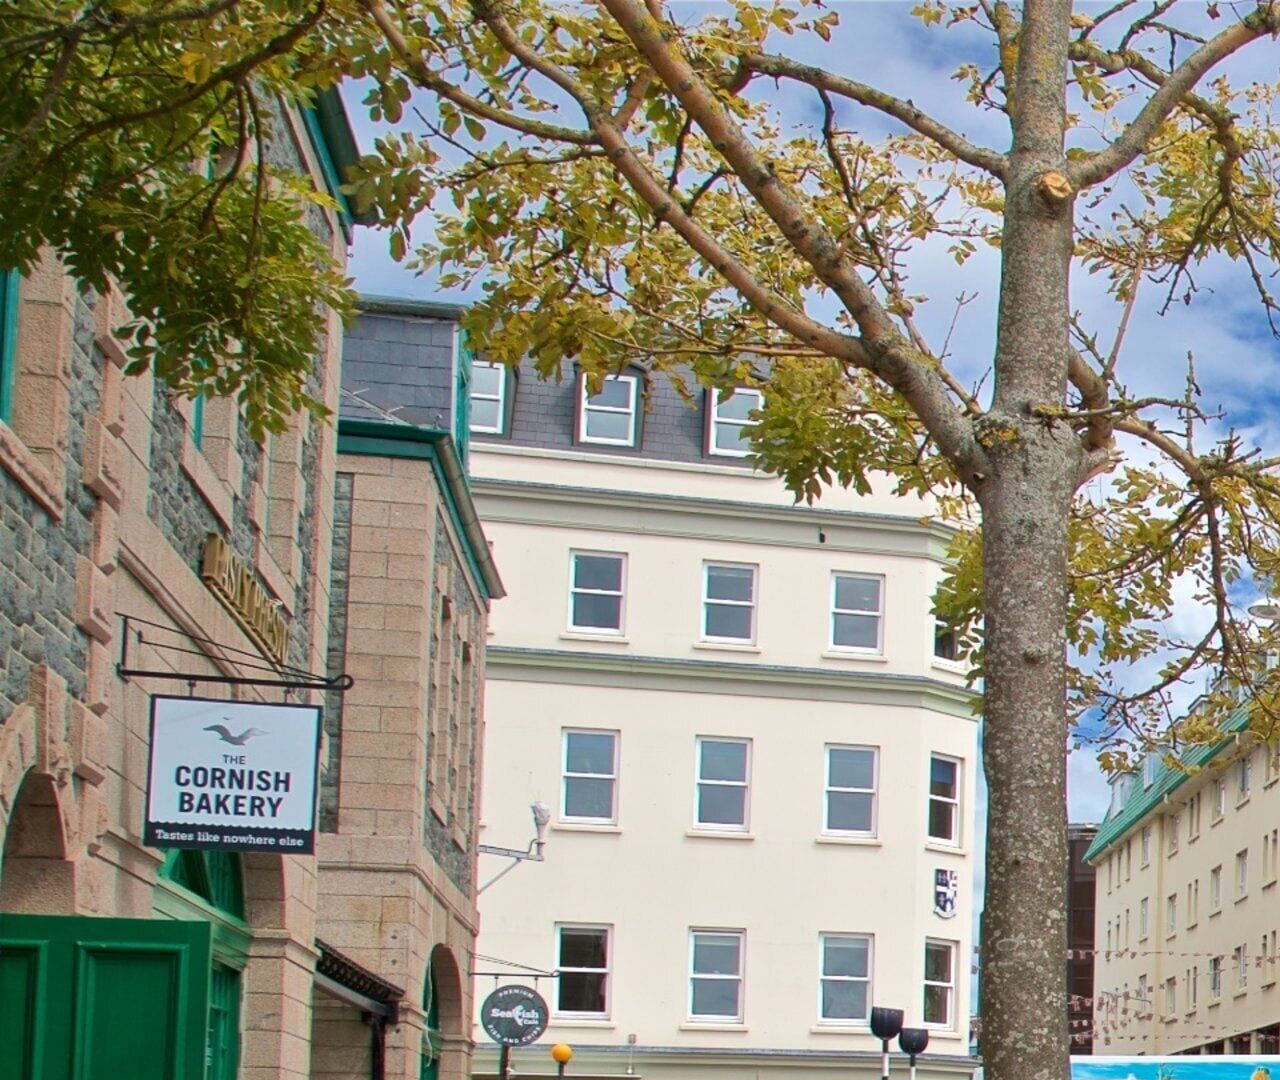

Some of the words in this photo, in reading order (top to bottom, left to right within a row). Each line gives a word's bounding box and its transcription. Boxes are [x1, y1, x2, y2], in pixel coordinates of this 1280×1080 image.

[222, 754, 246, 765] THE
[175, 765, 291, 792] CORNISH
[178, 791, 284, 817] BAKERY
[155, 829, 194, 841] Tastes
[197, 831, 220, 843] like
[223, 833, 276, 845] nowhere
[279, 836, 304, 846] else
